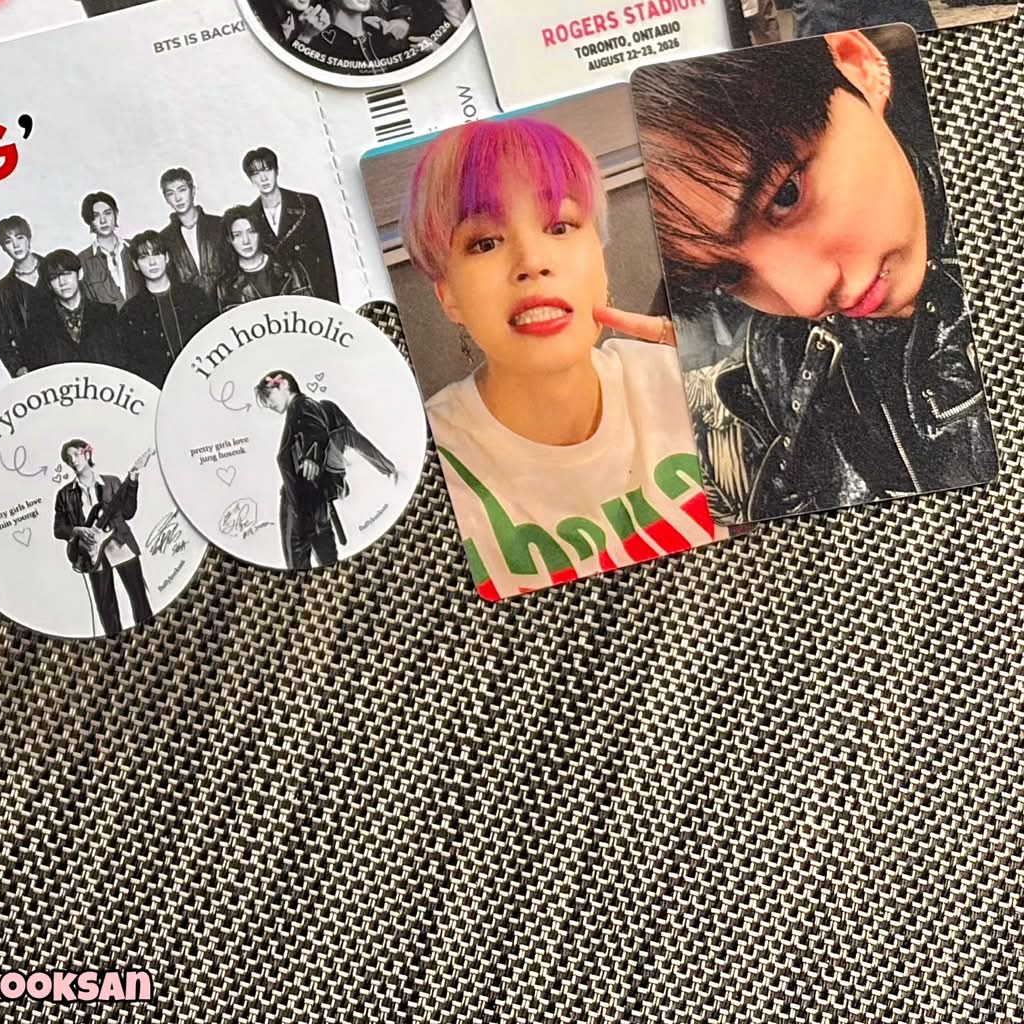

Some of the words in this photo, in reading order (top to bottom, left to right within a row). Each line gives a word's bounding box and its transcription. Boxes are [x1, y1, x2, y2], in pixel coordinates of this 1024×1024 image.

[152, 38, 182, 54] BTS
[184, 34, 198, 46] IS
[201, 20, 248, 42] BACK!
[291, 38, 326, 63] ROGERS
[327, 55, 367, 70] STADIUM
[368, 52, 403, 68] AUGUST
[430, 20, 451, 42] 2026
[541, 10, 619, 48] ROGERS
[574, 34, 631, 60] TORONTO,
[632, 20, 681, 44] ONTARIO
[588, 52, 625, 72] AUGUST
[626, 46, 657, 63] 22-23,
[658, 40, 680, 54] 2026
[190, 342, 234, 380] i'm
[229, 310, 355, 349] hobiholic
[190, 444, 214, 458] pretty
[214, 440, 232, 452] girls
[232, 436, 250, 447] love
[199, 453, 218, 466] jung
[218, 446, 246, 460] hoseok
[9, 504, 26, 518] girls
[26, 497, 42, 509] love
[14, 510, 40, 528] yoongi
